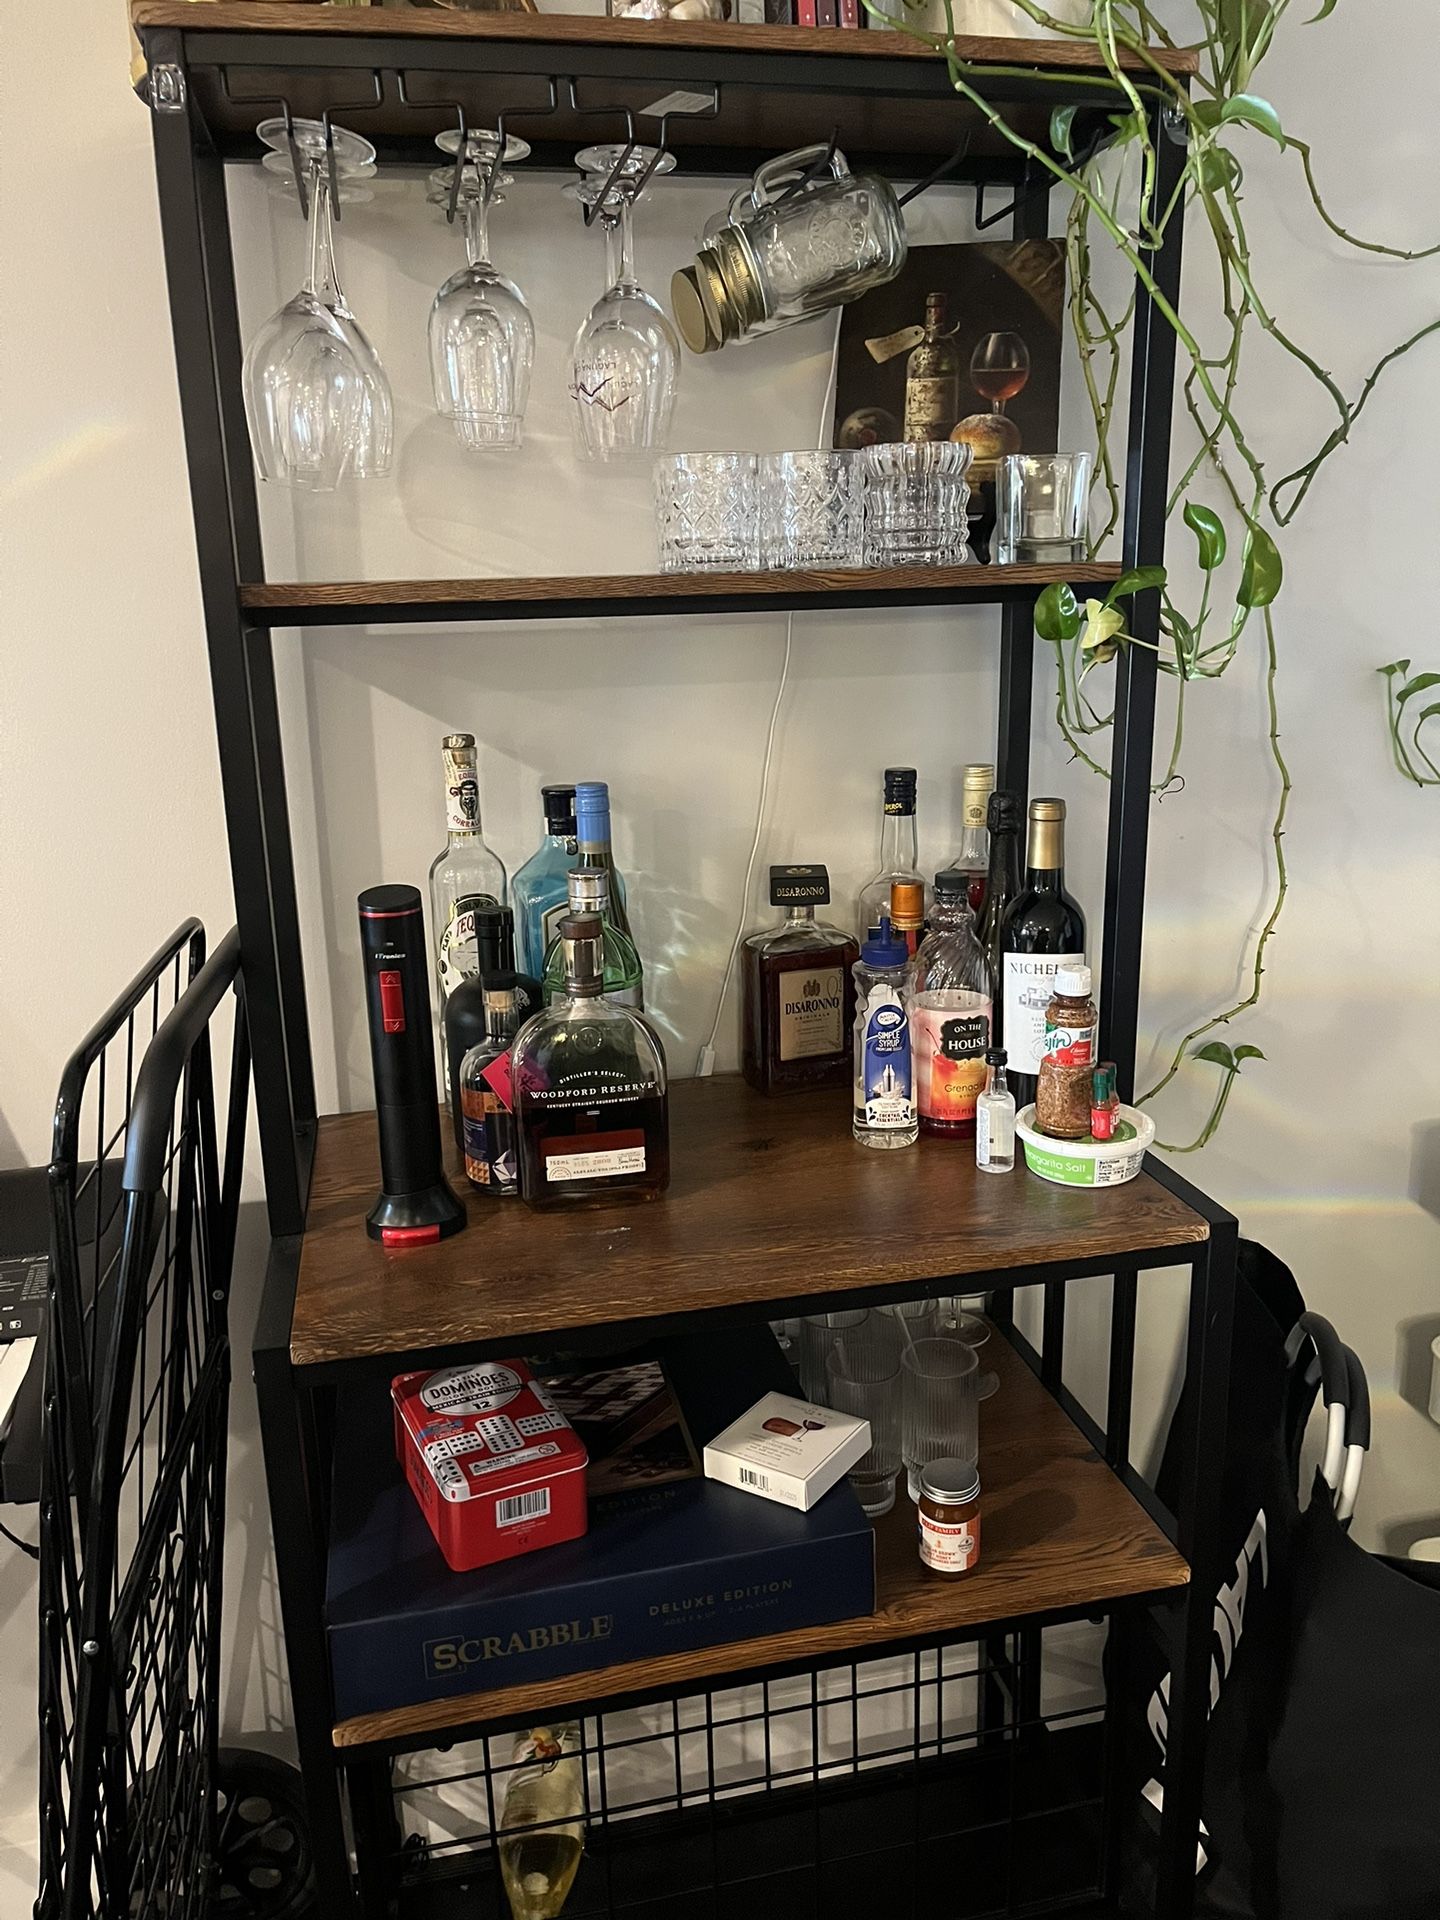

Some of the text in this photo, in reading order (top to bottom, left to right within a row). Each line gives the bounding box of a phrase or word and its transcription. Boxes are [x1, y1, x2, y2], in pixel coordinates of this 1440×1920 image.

[452, 814, 480, 828] CORRAL
[776, 886, 825, 898] DISARONNO
[785, 997, 840, 1016] DISARONNO
[878, 1030, 900, 1040] SIMPLE
[954, 1023, 982, 1034] ON THE
[878, 1039, 900, 1048] SYRUP
[948, 1035, 986, 1051] HOUSE
[559, 1070, 598, 1084] DISTILLER'S
[530, 1081, 653, 1100] WOODFORD RESERVE
[944, 1083, 981, 1093] Grenad
[1065, 1162, 1087, 1173] Salt
[429, 1371, 510, 1400] DOMINOES
[432, 1396, 467, 1410] MEXICAN
[468, 1391, 491, 1401] TRAIN
[473, 1401, 492, 1410] 12
[935, 1525, 960, 1535] FAMILY
[648, 1579, 793, 1617] DELUXE EDITION
[432, 1615, 611, 1671] SCRABBLE
